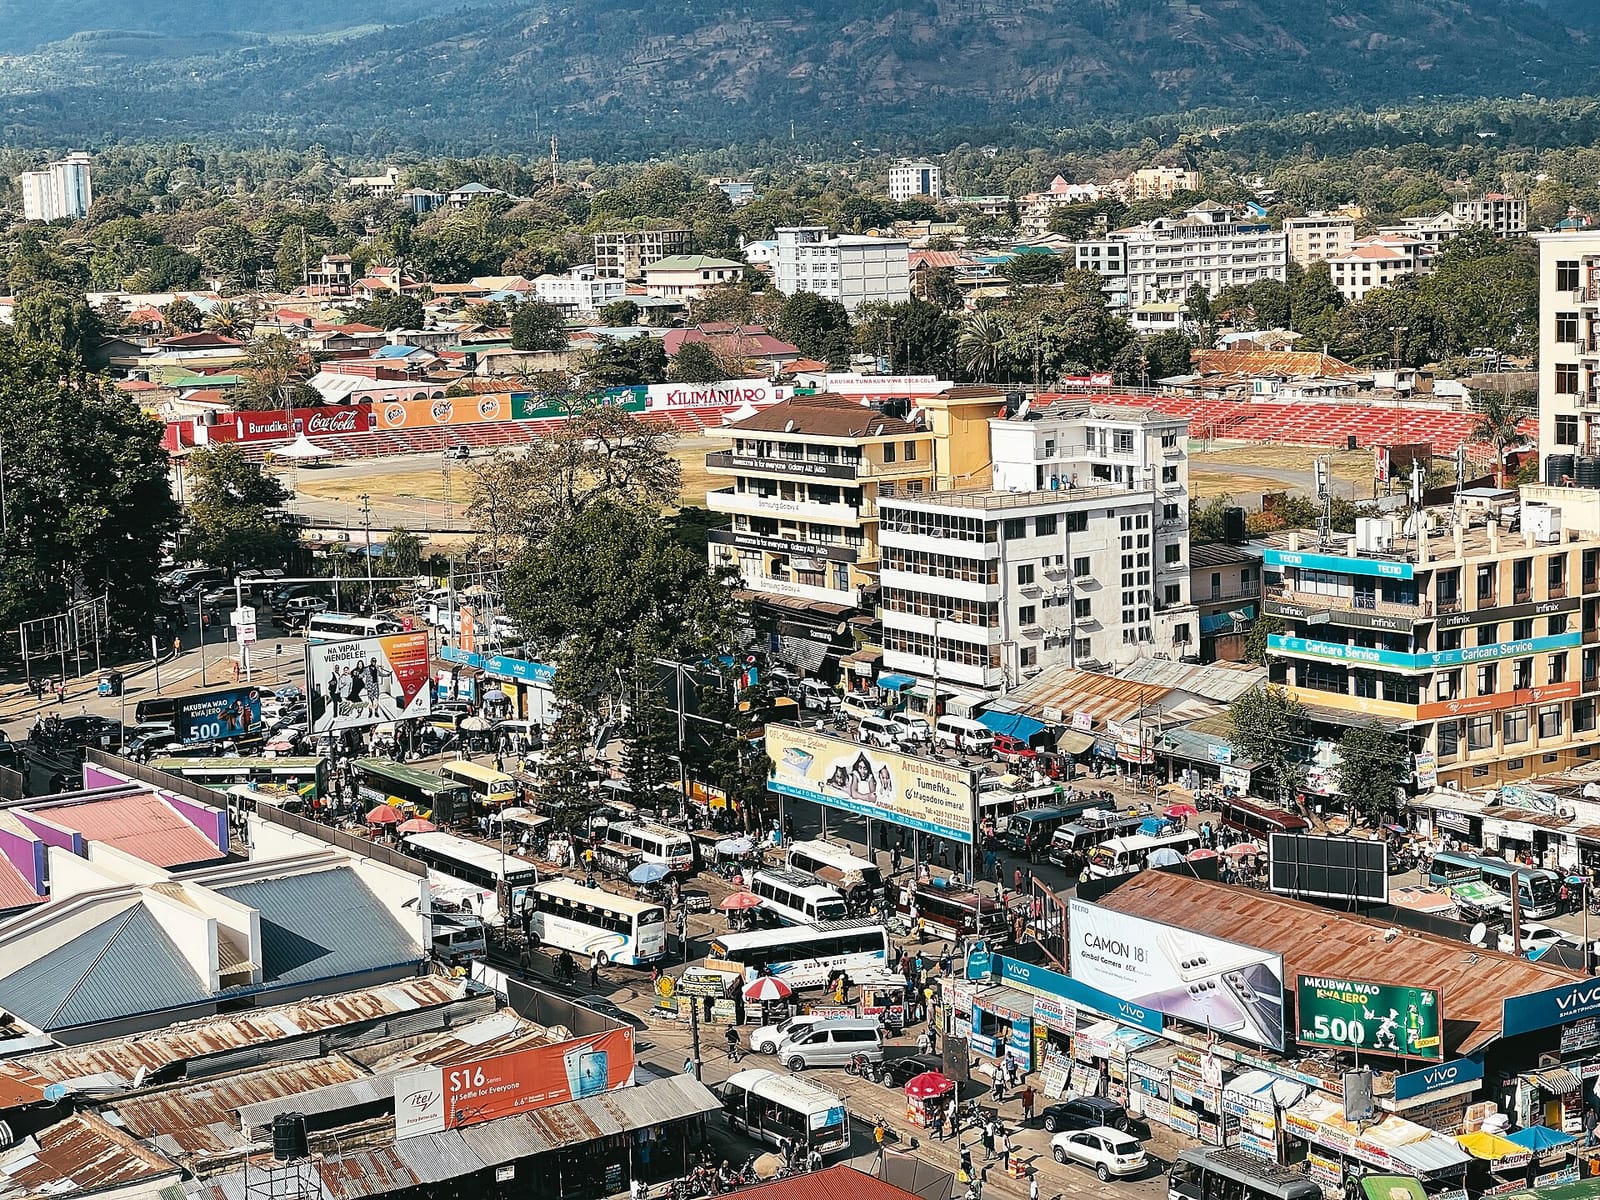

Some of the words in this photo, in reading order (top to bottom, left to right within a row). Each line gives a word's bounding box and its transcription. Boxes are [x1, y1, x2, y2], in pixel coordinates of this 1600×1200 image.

[666, 388, 766, 406] KILIMANJARO
[249, 422, 288, 434] Burudika
[1279, 554, 1302, 564] TECNO
[1377, 565, 1402, 575] TECNO
[1446, 614, 1470, 626] Infinix
[327, 647, 337, 655] NA
[338, 643, 360, 653] VIPAJI
[1345, 647, 1380, 661] Service
[1500, 641, 1533, 655] Service
[324, 650, 366, 663] VIENDELEE!
[183, 701, 212, 713] MKUBWA
[212, 699, 228, 708] WAO
[205, 708, 221, 717] JERO
[190, 722, 220, 741] 500
[902, 760, 930, 777] Arusha
[913, 791, 944, 806] Magodoro
[1071, 903, 1089, 914] TECNO
[1084, 932, 1129, 959] CAMON
[1134, 946, 1144, 963] 18
[1100, 956, 1122, 969] Camera
[1007, 963, 1030, 977] vivo
[1304, 976, 1352, 993] MKUBWA
[1354, 983, 1380, 995] WAO
[1316, 988, 1340, 1000] KWA
[1341, 992, 1368, 1004] JERO
[1118, 1002, 1145, 1019] vivo
[1314, 1014, 1365, 1045] 500
[1564, 1023, 1596, 1036] ARUSHA
[450, 1066, 485, 1093] S16
[1423, 1066, 1458, 1084] vivo
[478, 1087, 488, 1096] for
[489, 1082, 520, 1094] Everyone
[1322, 1080, 1344, 1094] NBS
[411, 1091, 433, 1105] itel
